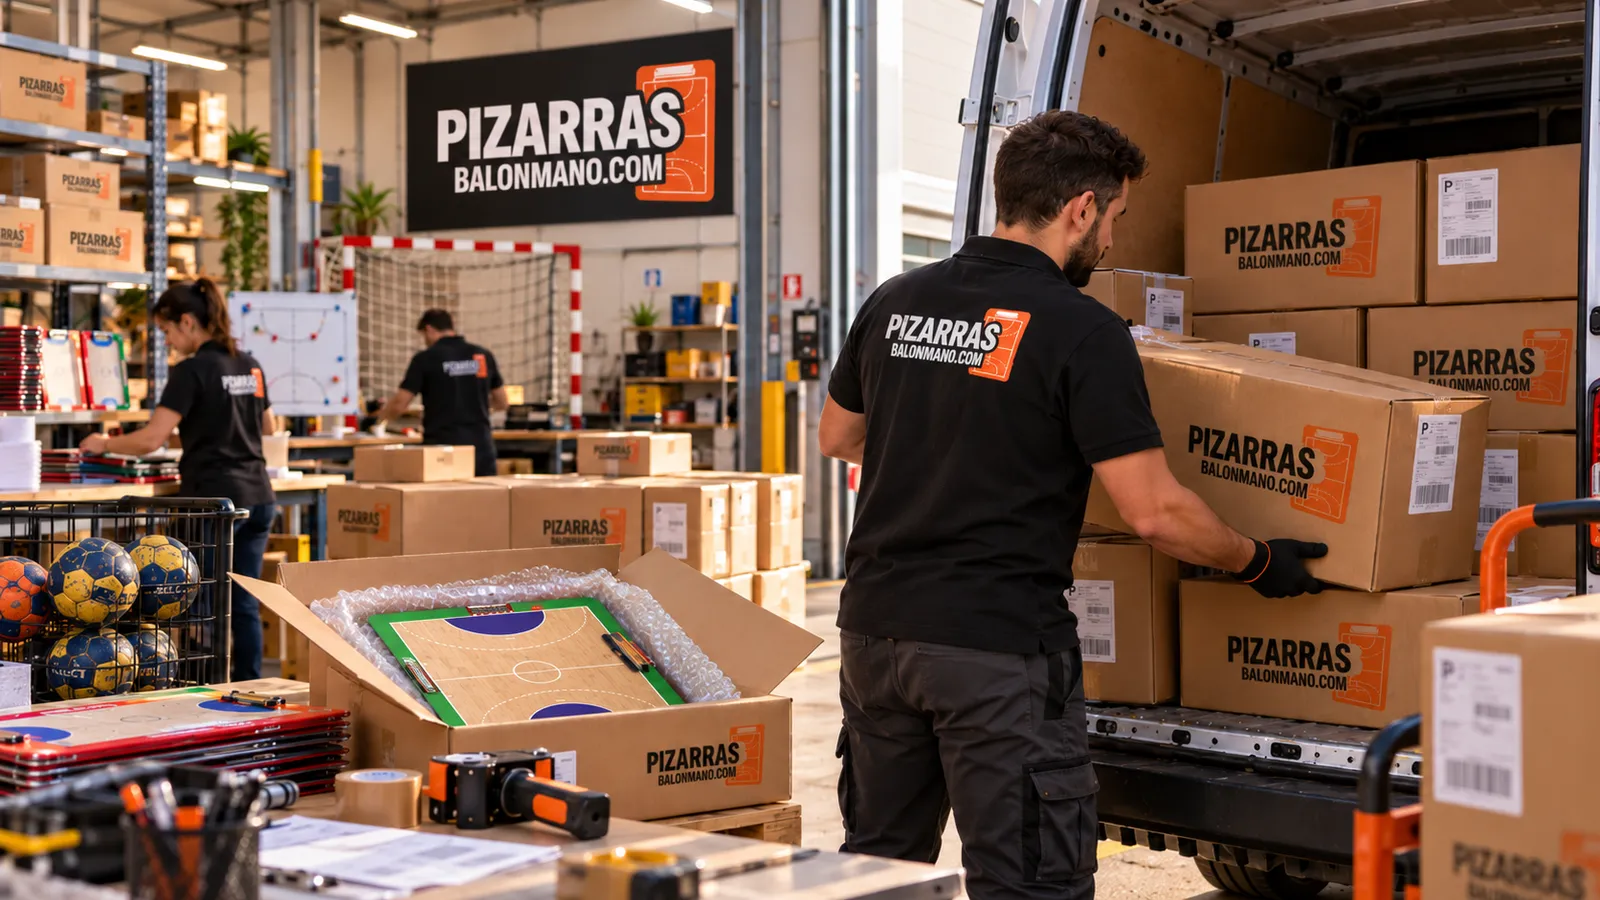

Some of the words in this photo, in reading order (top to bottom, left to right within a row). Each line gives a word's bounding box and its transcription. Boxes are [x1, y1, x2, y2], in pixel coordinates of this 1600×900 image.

[19, 76, 65, 95] PIZARRAS
[437, 91, 681, 162] PIZARRAS
[454, 153, 663, 193] BALONMANO.COM
[1444, 180, 1453, 193] P
[0, 227, 24, 241] RRAS
[70, 231, 121, 248] PIZARRAS
[1224, 218, 1345, 254] PIZARRAS
[1238, 250, 1341, 270] BALONMANO.COM
[1150, 293, 1156, 304] P
[885, 314, 1000, 351] PIZARRAS
[1253, 339, 1260, 348] P
[890, 342, 983, 366] BALONMANO.COM
[1413, 347, 1535, 376] PIZARRAS
[1421, 422, 1429, 435] P
[1188, 424, 1316, 480] PIZARRAS
[1200, 459, 1308, 499] BALONMANO.COM
[543, 518, 608, 535] PIZARRAS
[1227, 635, 1351, 673] PIZARRAS
[1241, 666, 1347, 691] BALONMANO.COM
[647, 742, 740, 774] PIZARRAS
[658, 766, 737, 786] BALONMANO.COM
